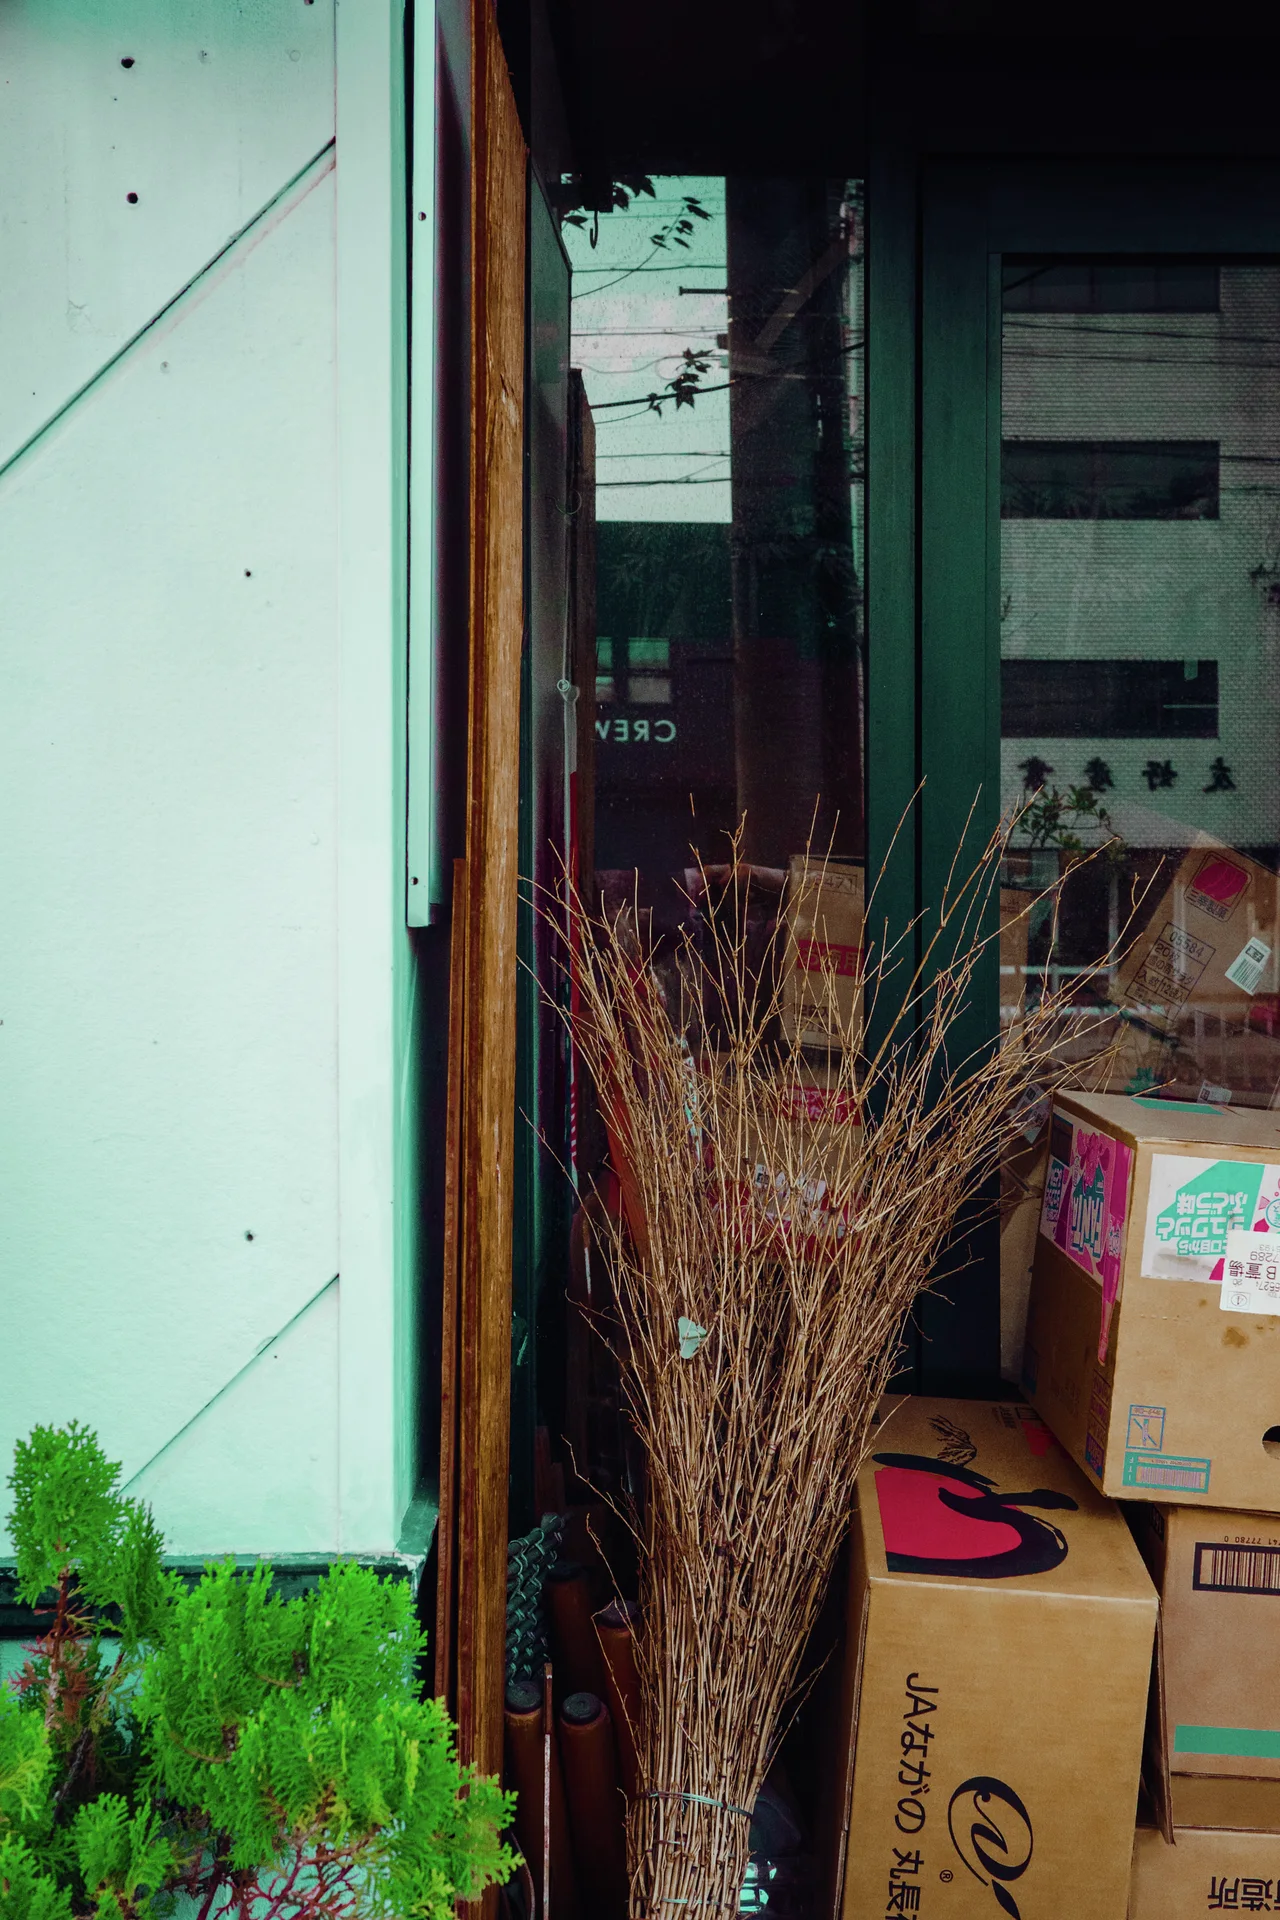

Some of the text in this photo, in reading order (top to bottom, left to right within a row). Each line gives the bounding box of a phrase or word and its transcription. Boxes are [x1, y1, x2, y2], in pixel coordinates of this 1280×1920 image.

[1169, 931, 1205, 958] 05584
[1177, 1191, 1248, 1216] ぶどう味
[1178, 1239, 1227, 1254] 口目から
[884, 1672, 939, 1920] JAながの 丸長
[1207, 1876, 1280, 1912] 造所
